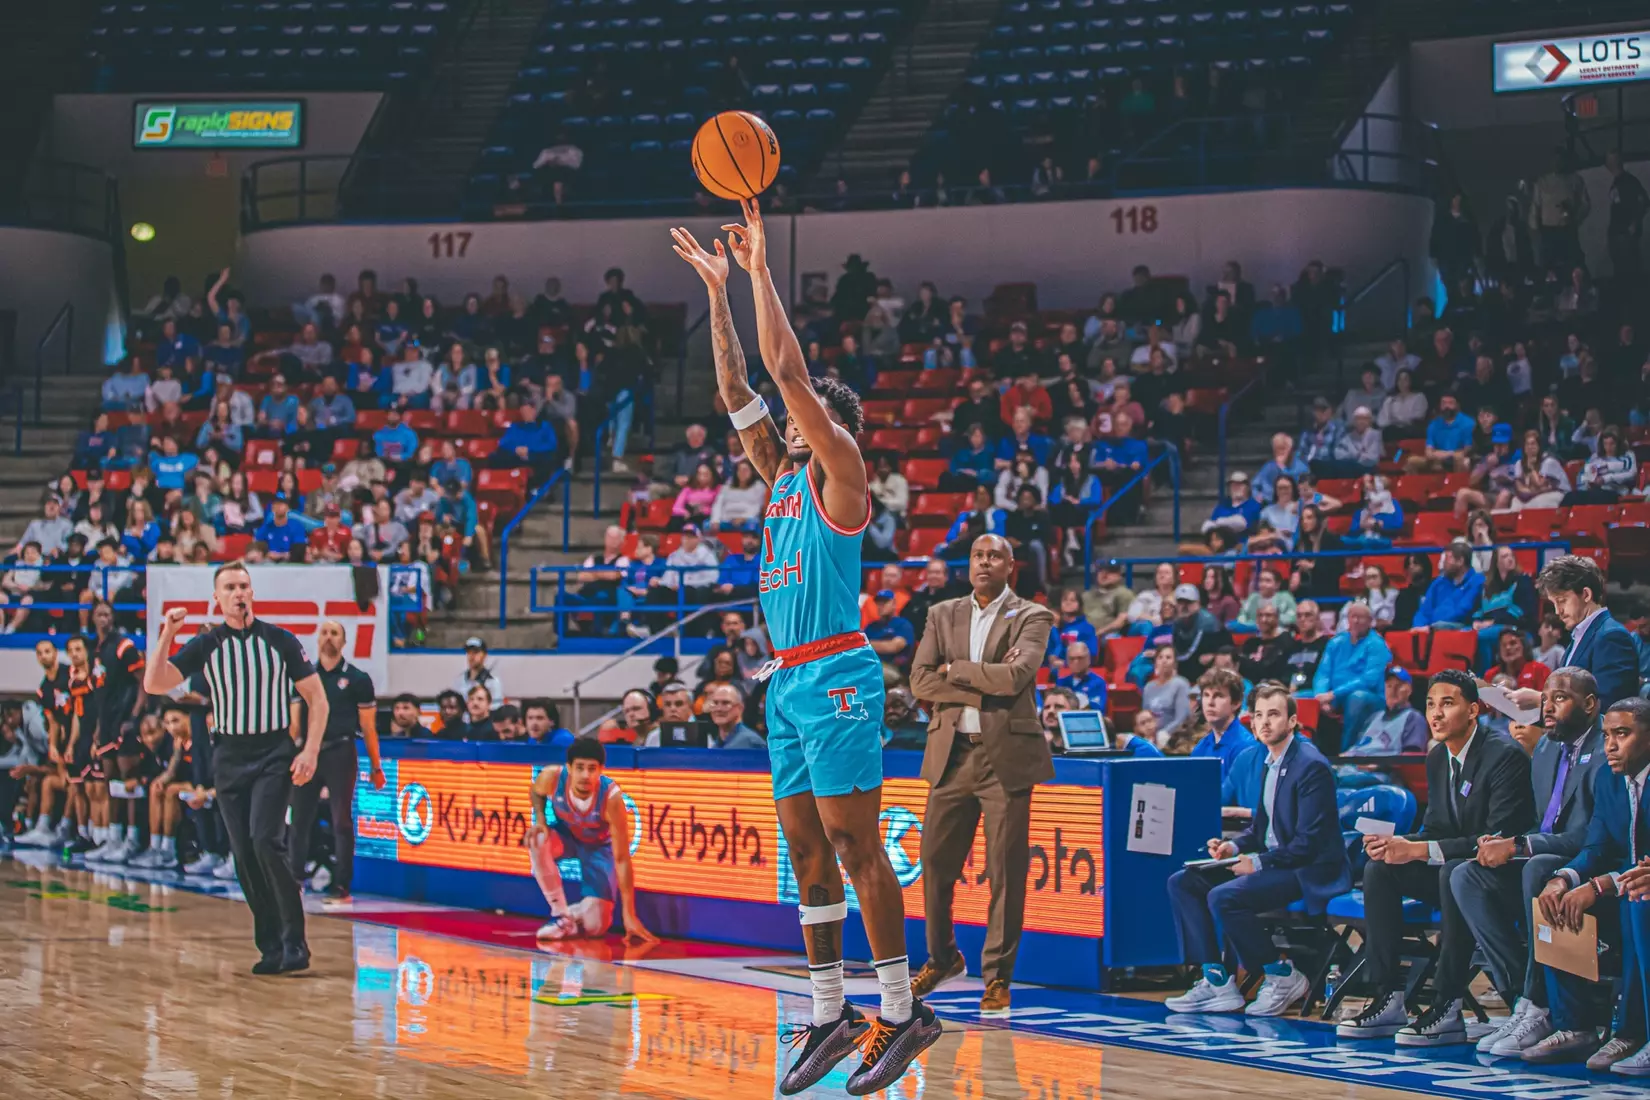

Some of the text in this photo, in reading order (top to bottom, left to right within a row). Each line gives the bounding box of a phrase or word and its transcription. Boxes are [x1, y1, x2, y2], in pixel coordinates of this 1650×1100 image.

[1578, 37, 1641, 63] LOTS
[175, 111, 294, 134] rapidSIGNS
[1110, 205, 1159, 235] 118
[428, 231, 473, 259] 117
[759, 548, 803, 594] ECH
[827, 686, 858, 713] T
[438, 792, 529, 847] Kubota
[648, 803, 763, 866] Kubota
